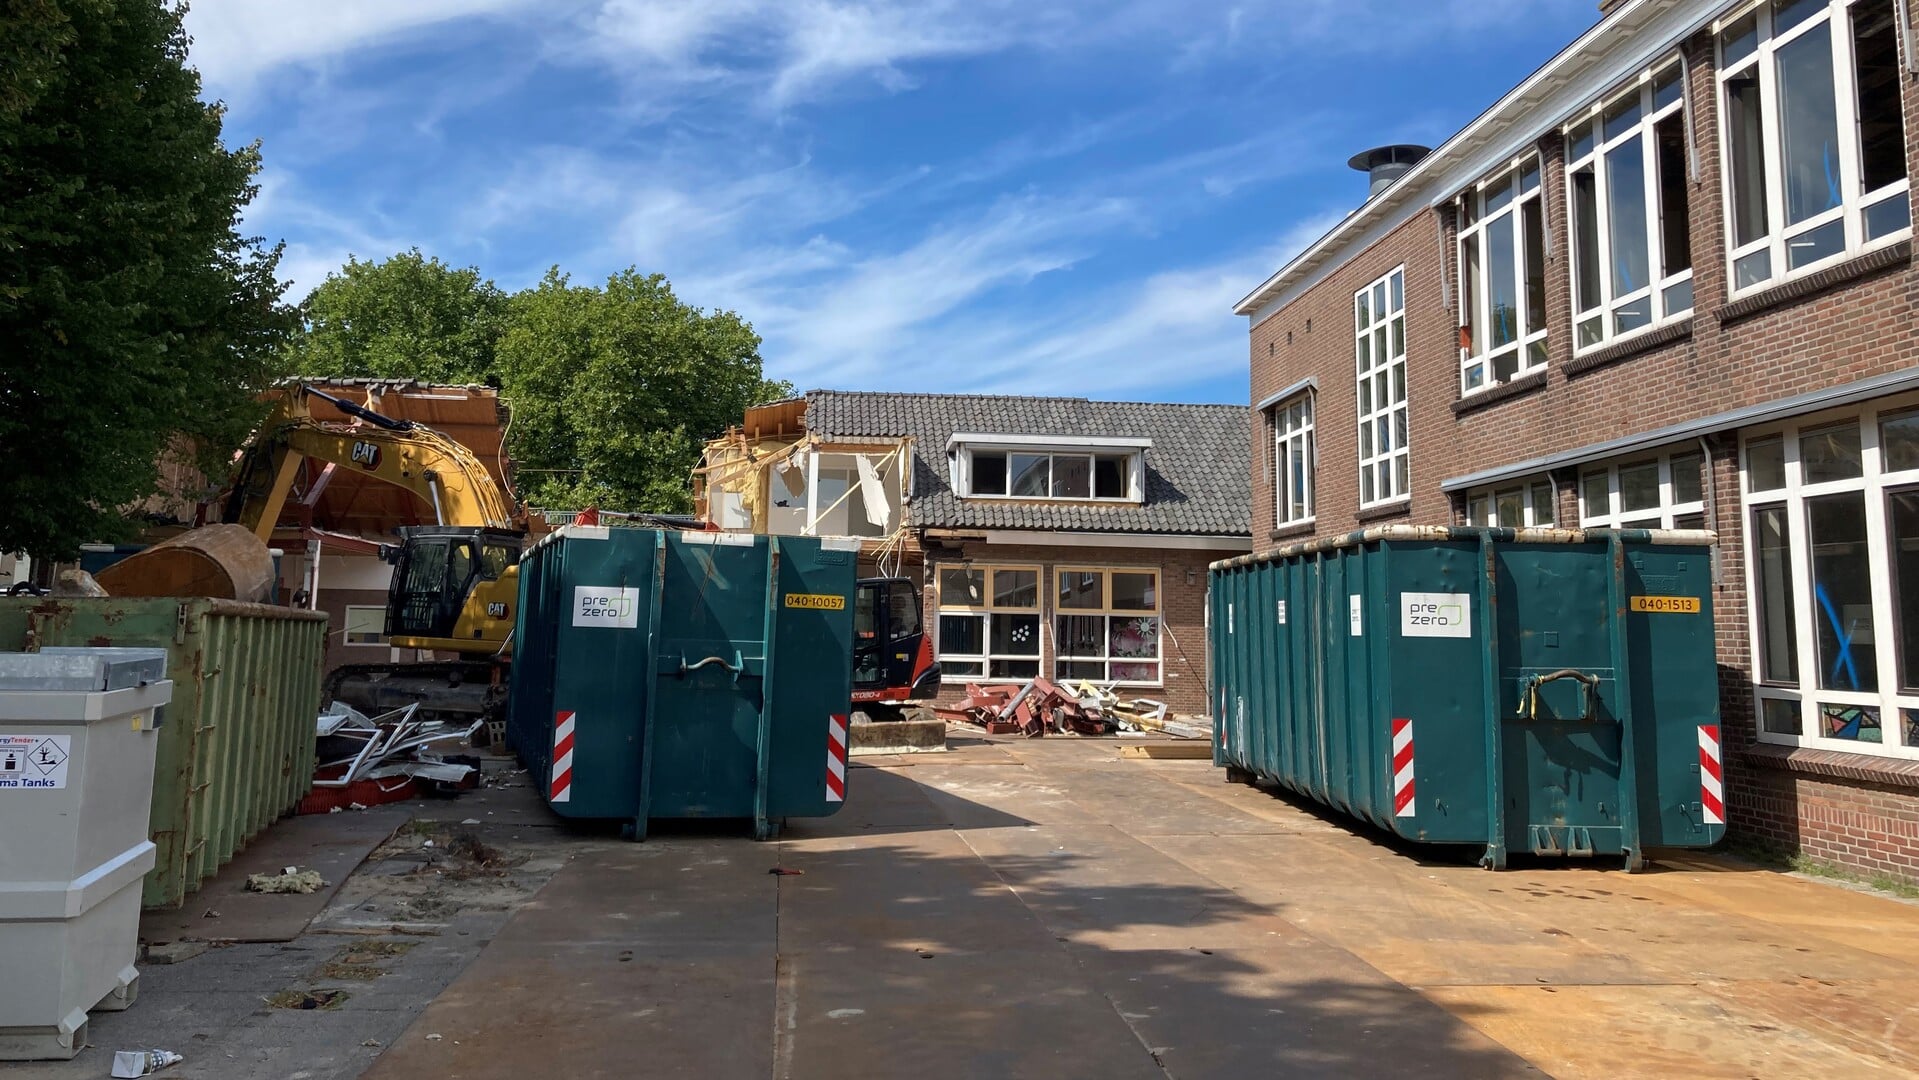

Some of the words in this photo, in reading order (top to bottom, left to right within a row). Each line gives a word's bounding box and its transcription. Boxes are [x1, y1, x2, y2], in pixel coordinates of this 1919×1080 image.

[351, 441, 378, 465] CAT
[582, 596, 609, 607] pre
[787, 595, 843, 608] 040-10057
[1639, 598, 1692, 610] 040-1513
[488, 602, 505, 616] CAT
[582, 608, 617, 617] zero
[1410, 603, 1437, 615] pre
[1410, 616, 1448, 625] zero
[21, 778, 55, 787] Tanks
